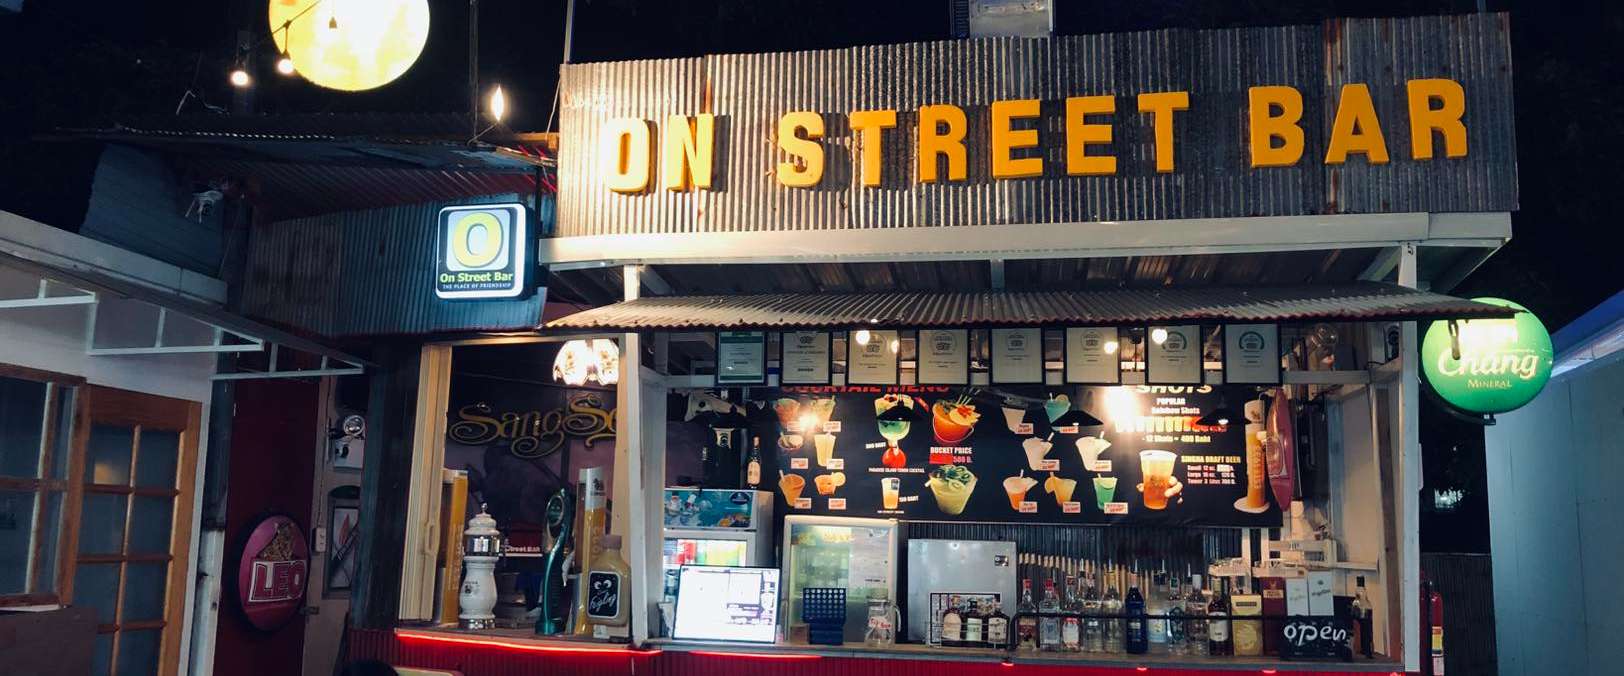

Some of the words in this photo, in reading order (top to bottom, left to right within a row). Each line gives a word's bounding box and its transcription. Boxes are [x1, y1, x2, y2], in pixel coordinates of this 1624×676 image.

[605, 112, 714, 192] ON
[775, 91, 1189, 189] STREET
[1248, 77, 1468, 169] BAR
[440, 273, 455, 283] On
[458, 271, 492, 282] Street
[494, 271, 513, 281] Bar
[1437, 349, 1539, 379] Chang
[1467, 378, 1512, 389] MINERAL
[248, 560, 308, 602] LEO
[1284, 624, 1346, 646] open
